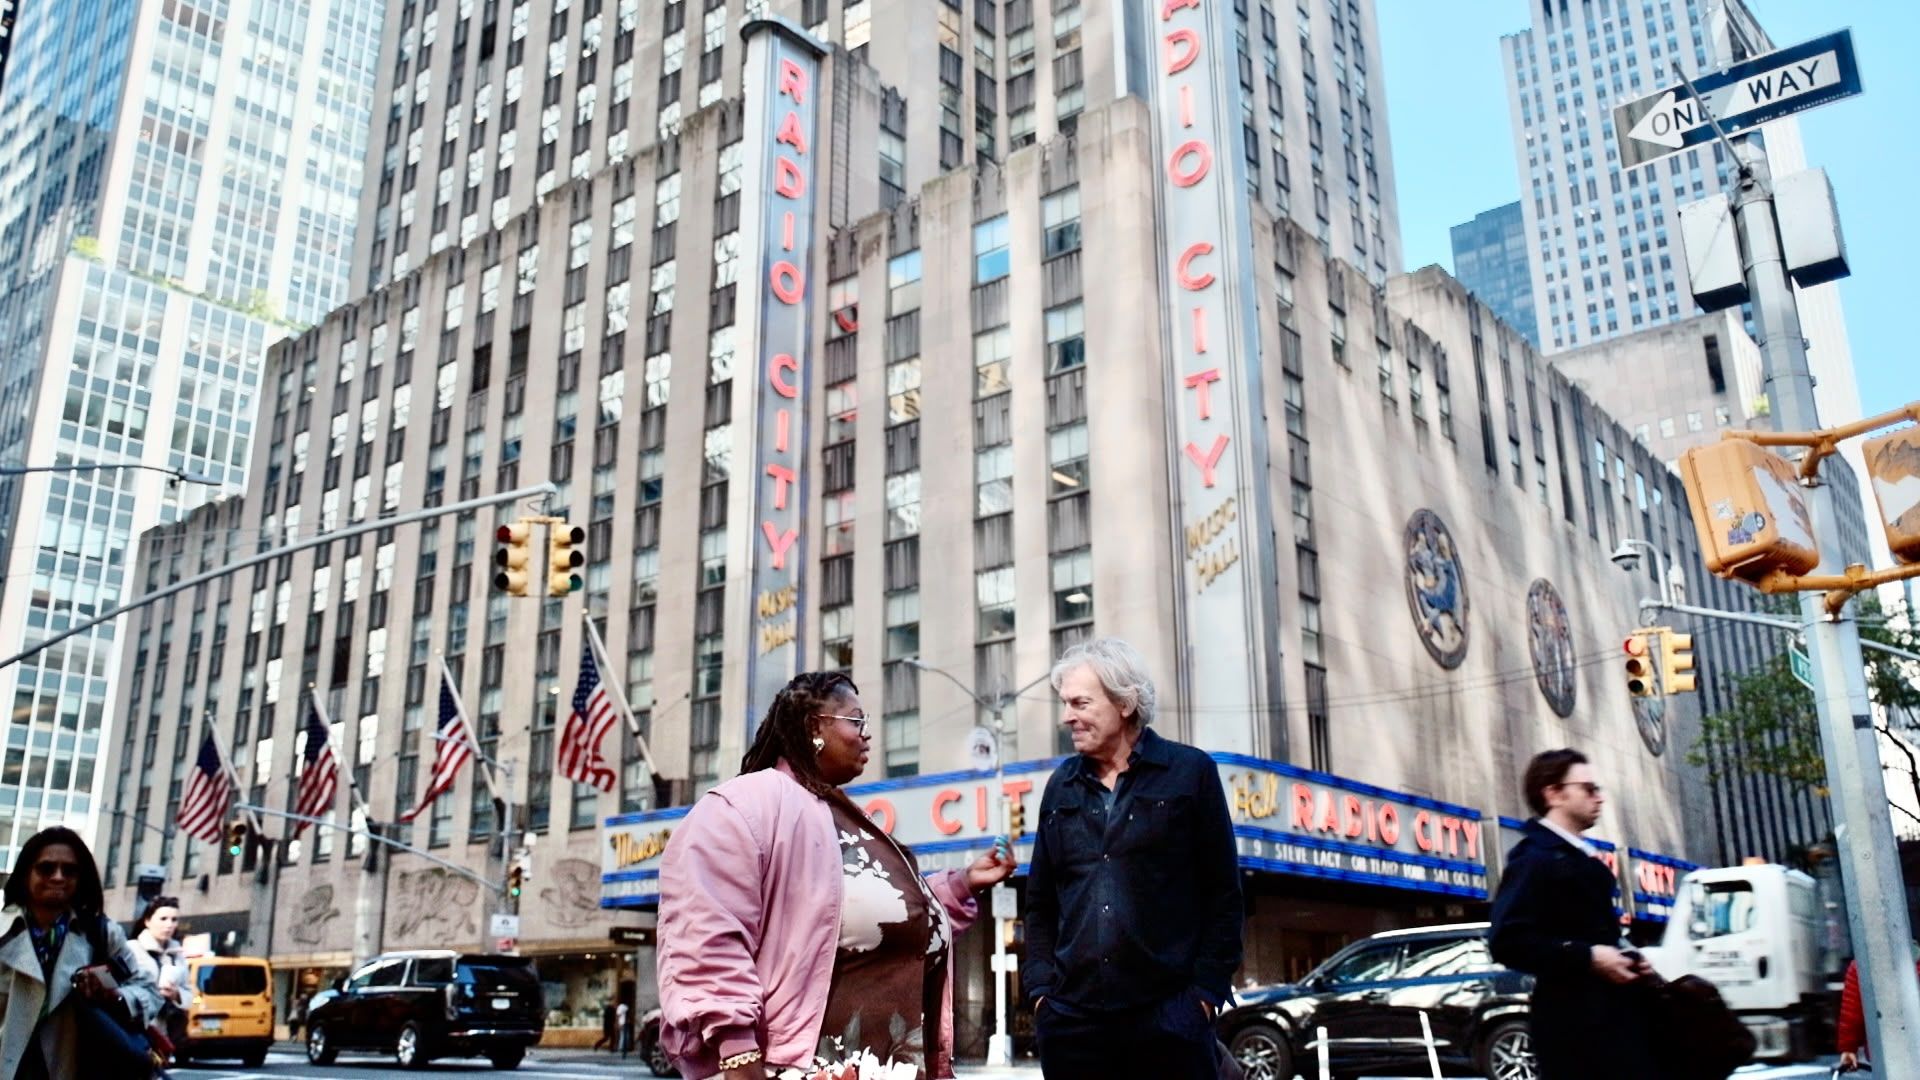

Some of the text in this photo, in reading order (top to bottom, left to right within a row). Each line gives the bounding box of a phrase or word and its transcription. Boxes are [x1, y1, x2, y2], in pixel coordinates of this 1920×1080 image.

[1651, 59, 1821, 137] ONE WAY
[1162, 0, 1229, 489] DIO CITY
[762, 57, 805, 570] RADIO CITY
[932, 780, 1034, 836] CIT
[1291, 782, 1479, 859] RADIO CITY
[1274, 843, 1308, 864] STEVE
[1639, 860, 1676, 896] CITY
